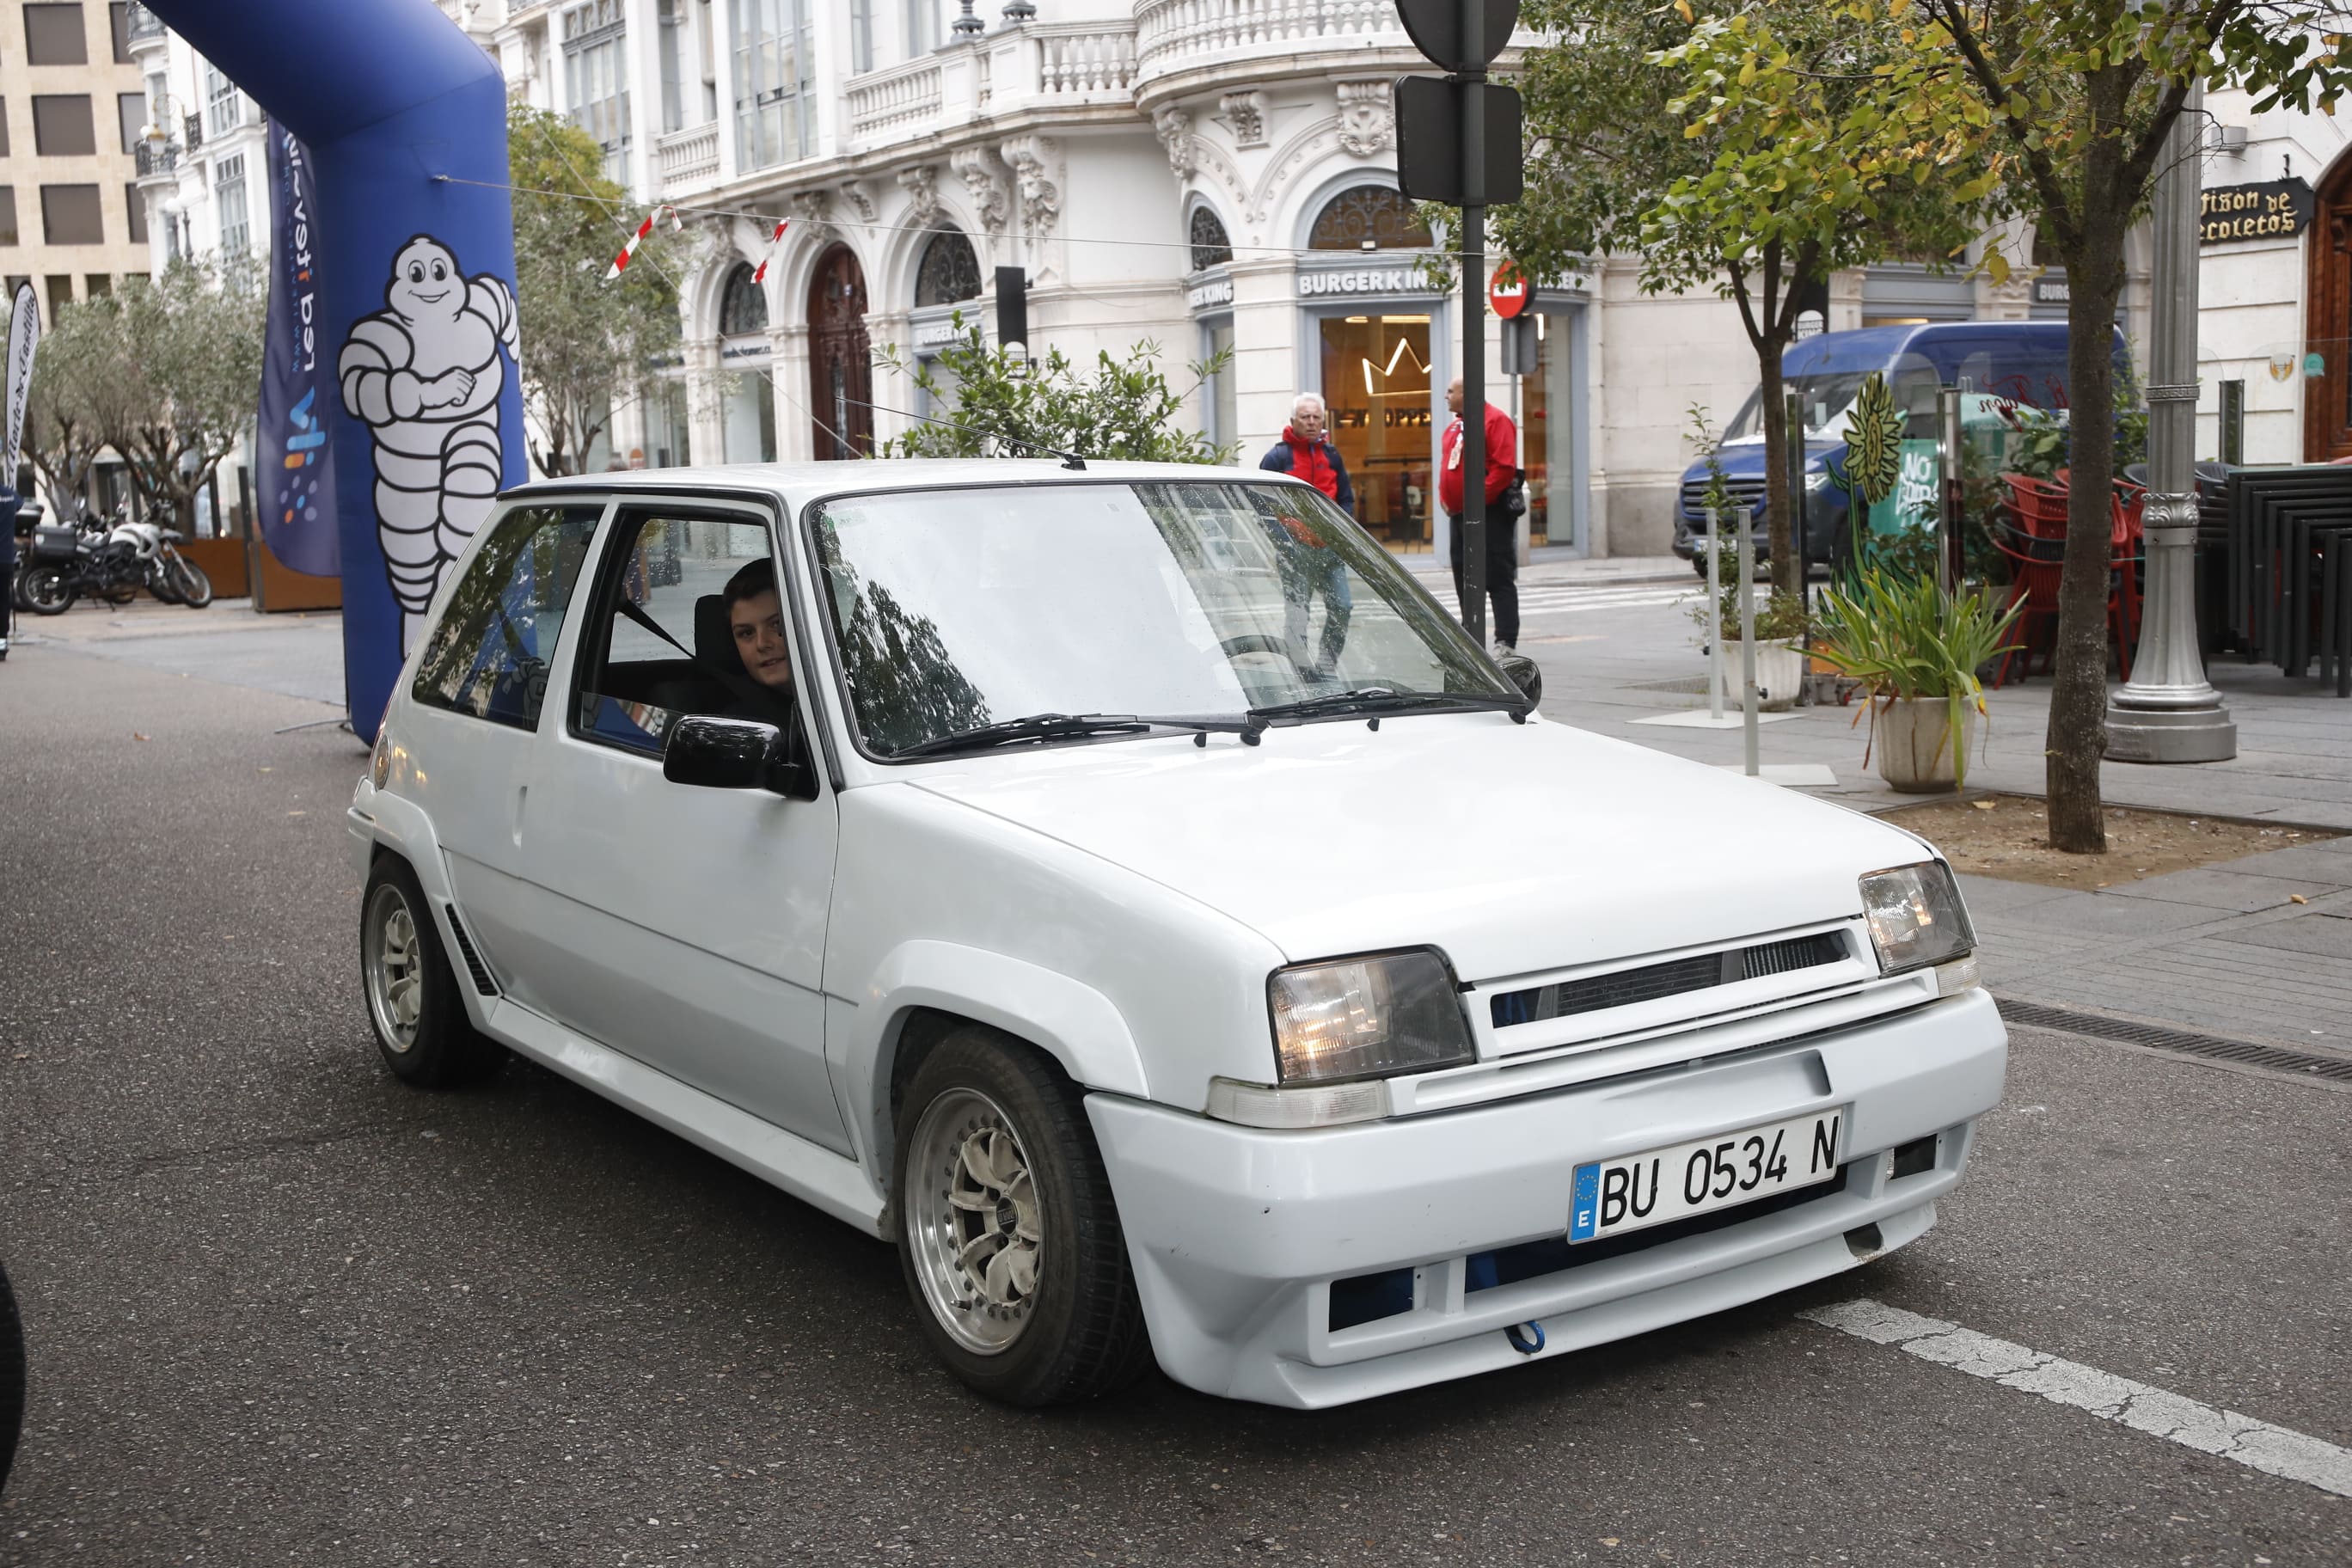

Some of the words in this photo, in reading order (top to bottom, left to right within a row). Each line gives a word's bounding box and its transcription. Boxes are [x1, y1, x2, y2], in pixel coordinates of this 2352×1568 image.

[2265, 192, 2292, 213] de
[1299, 271, 1385, 295] BURGER
[1904, 452, 1932, 481] NO
[1600, 1157, 1660, 1228] BU
[1684, 1129, 1787, 1205] 0534
[1811, 1115, 1840, 1174] N
[1577, 1210, 1590, 1228] E
